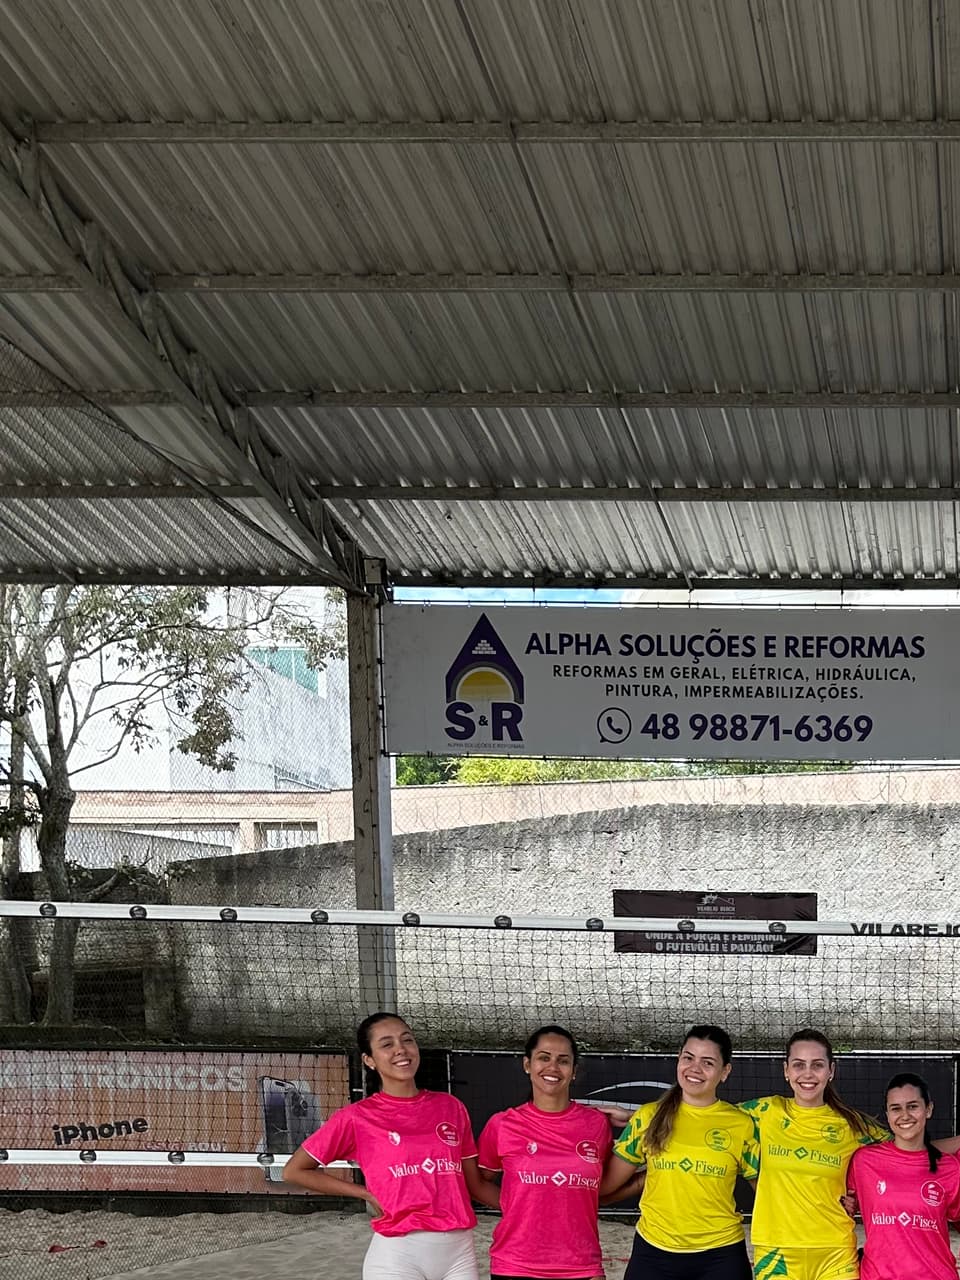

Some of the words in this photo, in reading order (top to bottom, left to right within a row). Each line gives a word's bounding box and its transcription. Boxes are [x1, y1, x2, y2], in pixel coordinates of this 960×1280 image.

[525, 633, 612, 656] ALPHA
[619, 628, 756, 664] SOLUÇÕES
[764, 636, 776, 657] E
[785, 636, 925, 658] REFORMAS
[553, 665, 637, 679] REFORMAS
[643, 667, 665, 679] EM
[670, 667, 726, 681] GERAL,
[732, 664, 809, 683] ELÉTRICA,
[815, 664, 916, 683] HIDRÁULICA,
[605, 684, 679, 699] PINTURA,
[684, 683, 864, 703] IMPERMEABILIZAÇÕES.
[640, 713, 680, 740] 48
[689, 713, 873, 742] 98871-6369
[655, 942, 663, 951] O
[52, 1117, 149, 1146] iPhone
[652, 1158, 677, 1171] Valor
[695, 1160, 728, 1177] Fiscal
[810, 1149, 841, 1167] Fiscal
[389, 1163, 420, 1179] Valor
[518, 1171, 549, 1185] Valor
[871, 1212, 896, 1225] Valor
